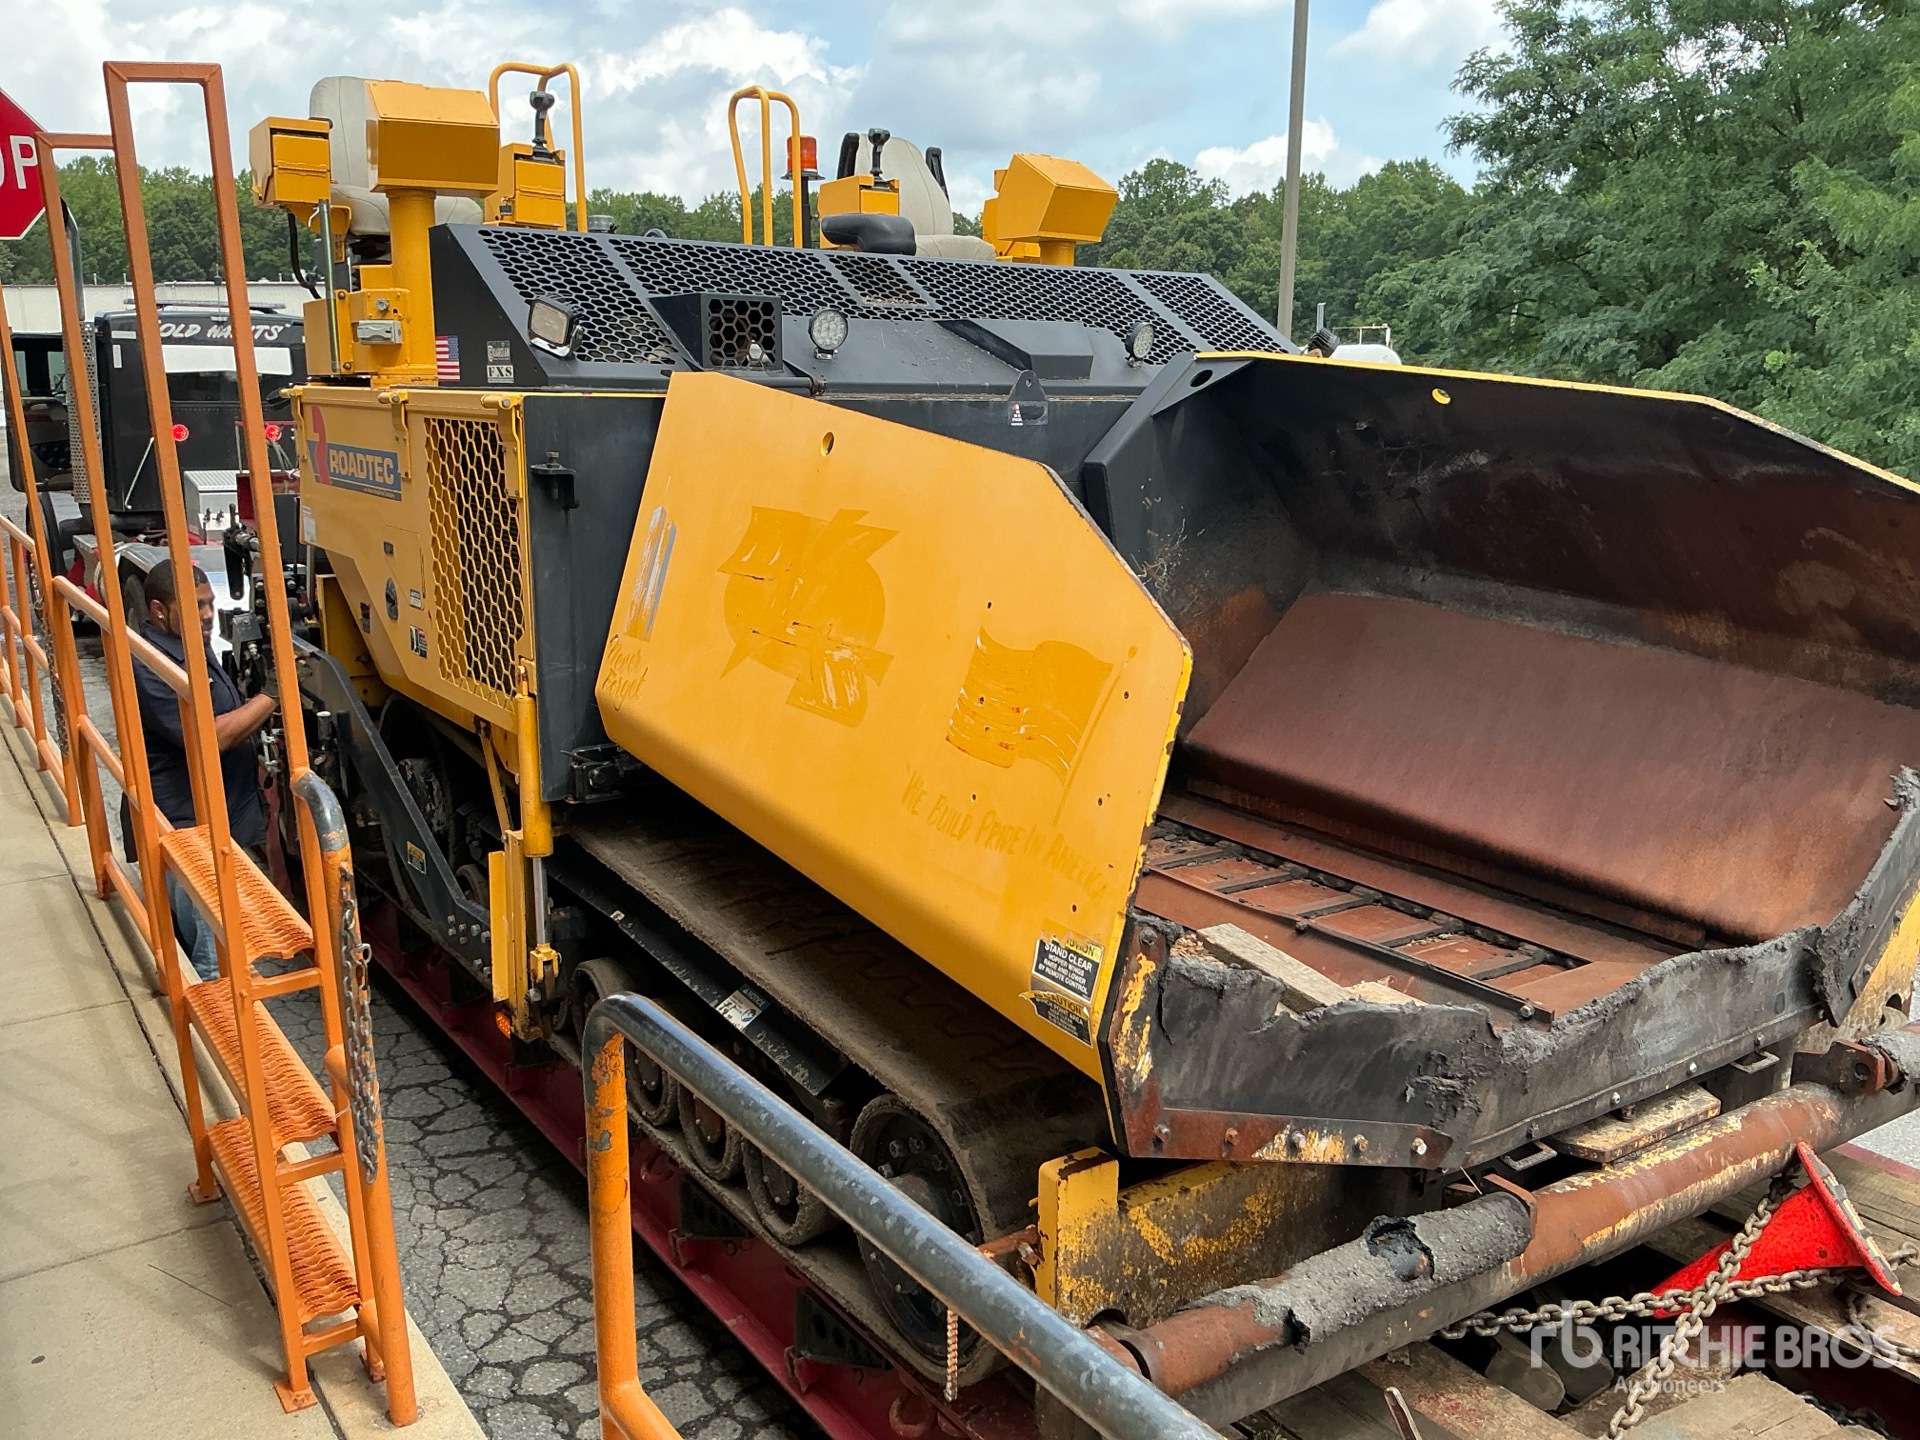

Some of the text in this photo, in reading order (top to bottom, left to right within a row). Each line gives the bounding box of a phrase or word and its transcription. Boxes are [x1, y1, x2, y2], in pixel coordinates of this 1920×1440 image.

[488, 366, 512, 377] FXS
[328, 448, 395, 486] ROADTEC
[1045, 942, 1093, 973] STAND CLEAR
[1048, 953, 1069, 968] HOPPER
[1045, 966, 1066, 983] REMOTE
[1064, 976, 1088, 995] CONTROL
[1068, 971, 1087, 985] LOWER
[748, 989, 766, 1007] NOTICE
